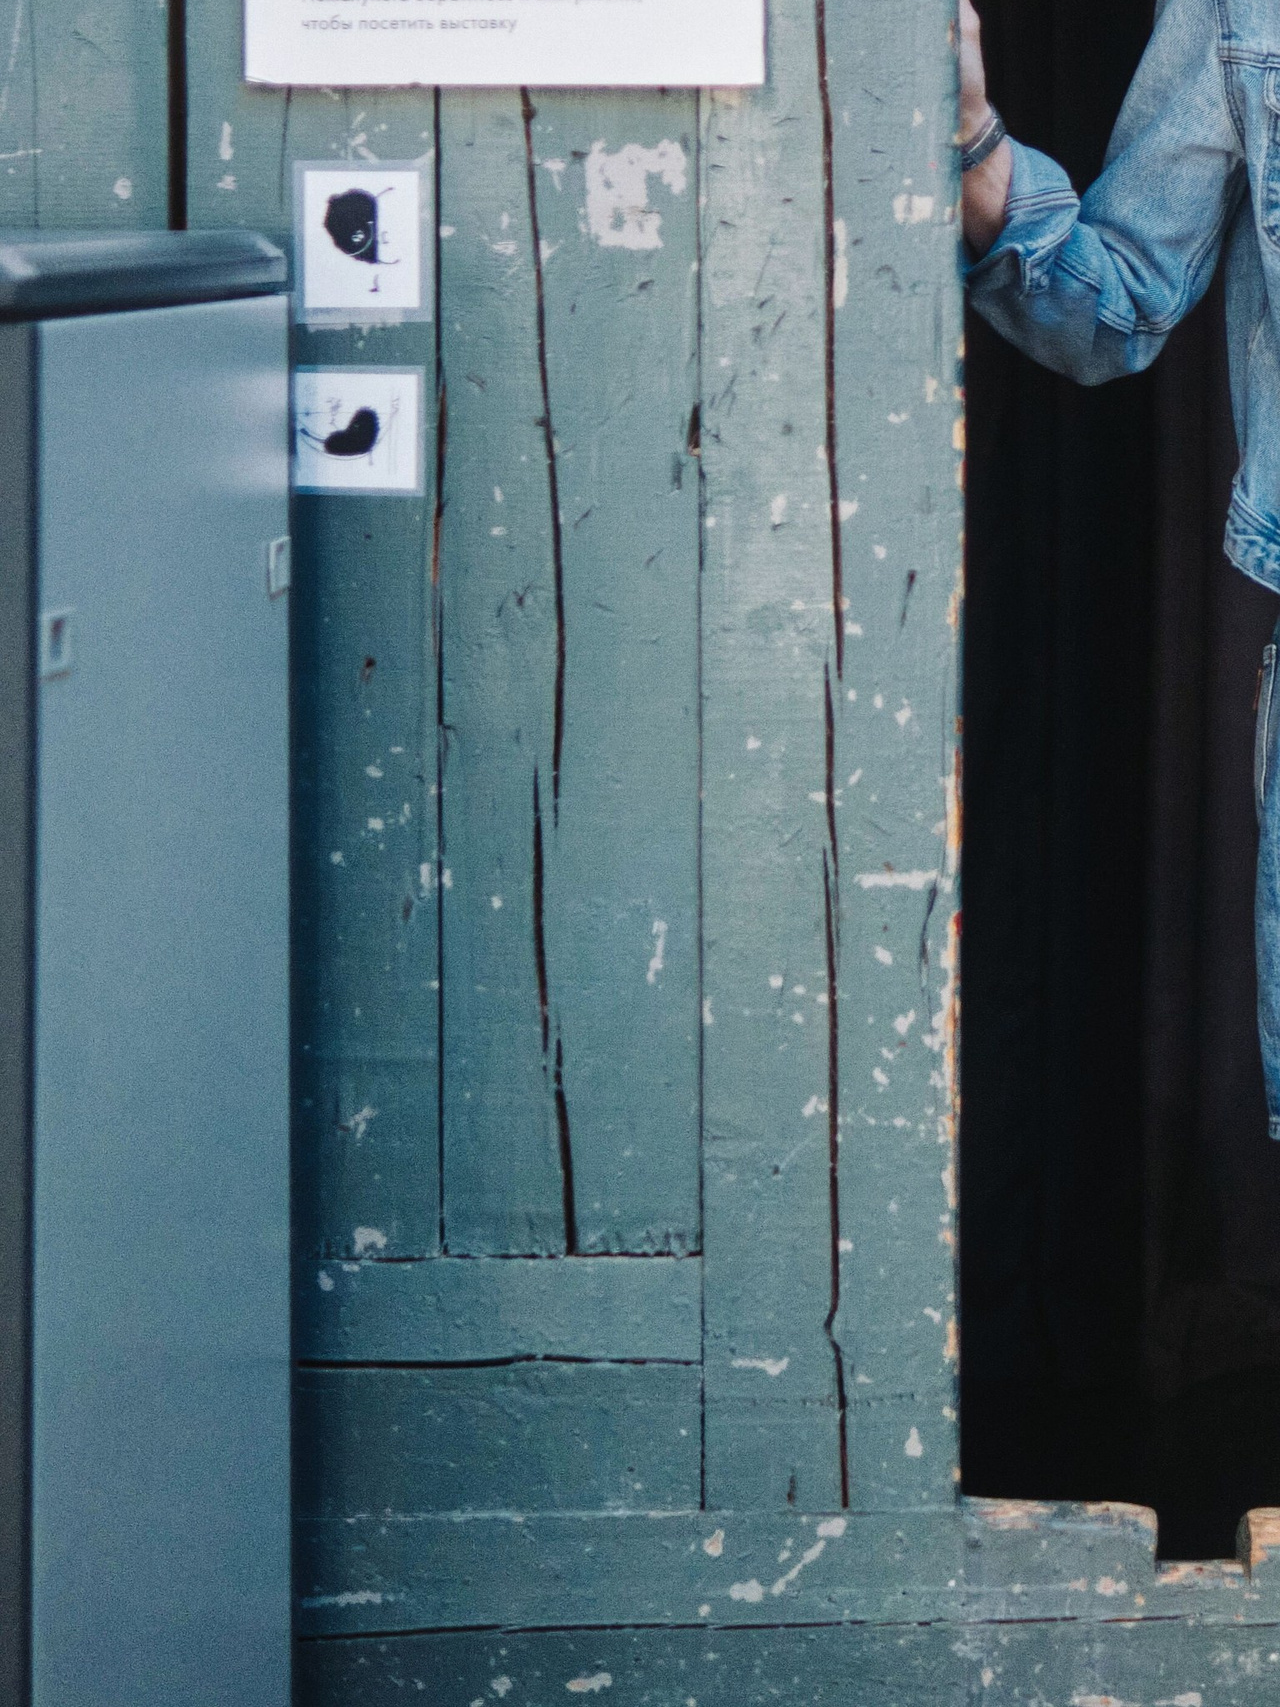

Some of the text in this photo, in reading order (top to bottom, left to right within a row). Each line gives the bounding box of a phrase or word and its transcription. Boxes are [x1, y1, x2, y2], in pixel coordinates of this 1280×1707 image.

[301, 14, 518, 35] чтобы посетить выставку
